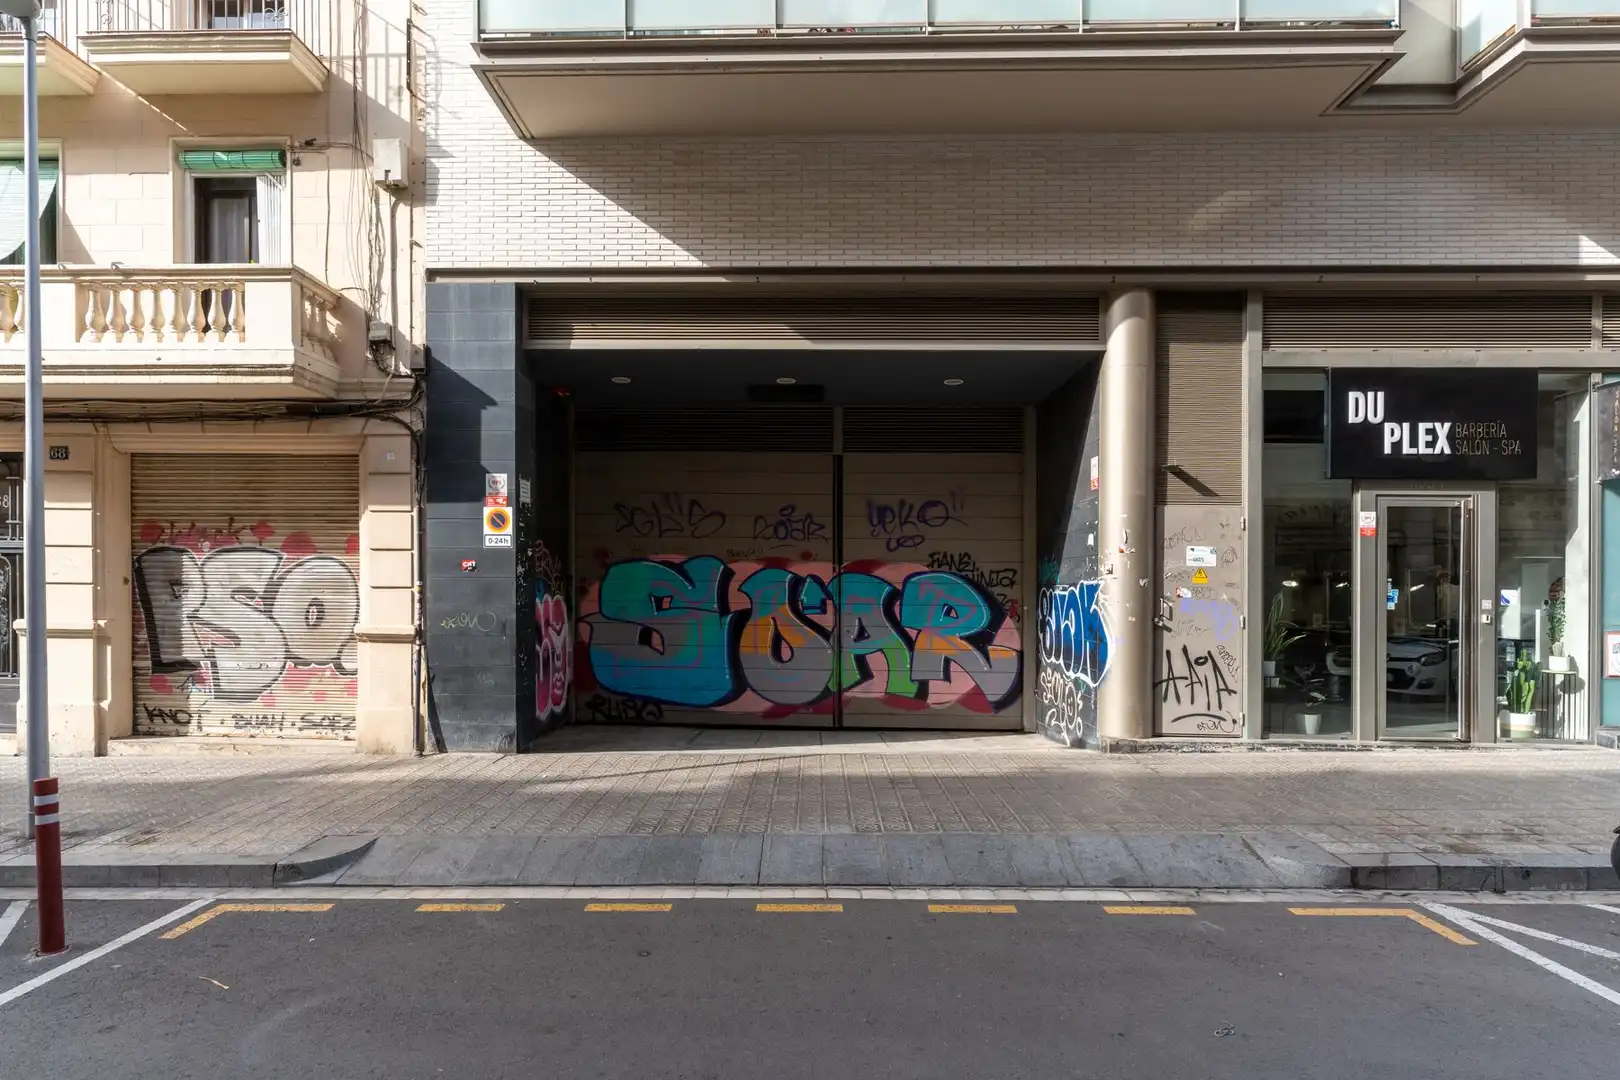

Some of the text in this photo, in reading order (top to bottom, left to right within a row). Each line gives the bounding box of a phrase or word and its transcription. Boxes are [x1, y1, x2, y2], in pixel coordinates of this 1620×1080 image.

[1348, 391, 1384, 424] DU
[1383, 422, 1452, 455] PLEX
[1455, 420, 1508, 438] BARBERÍA
[50, 447, 66, 458] 68
[1455, 436, 1490, 455] SALÓN
[1501, 438, 1522, 455] SPA
